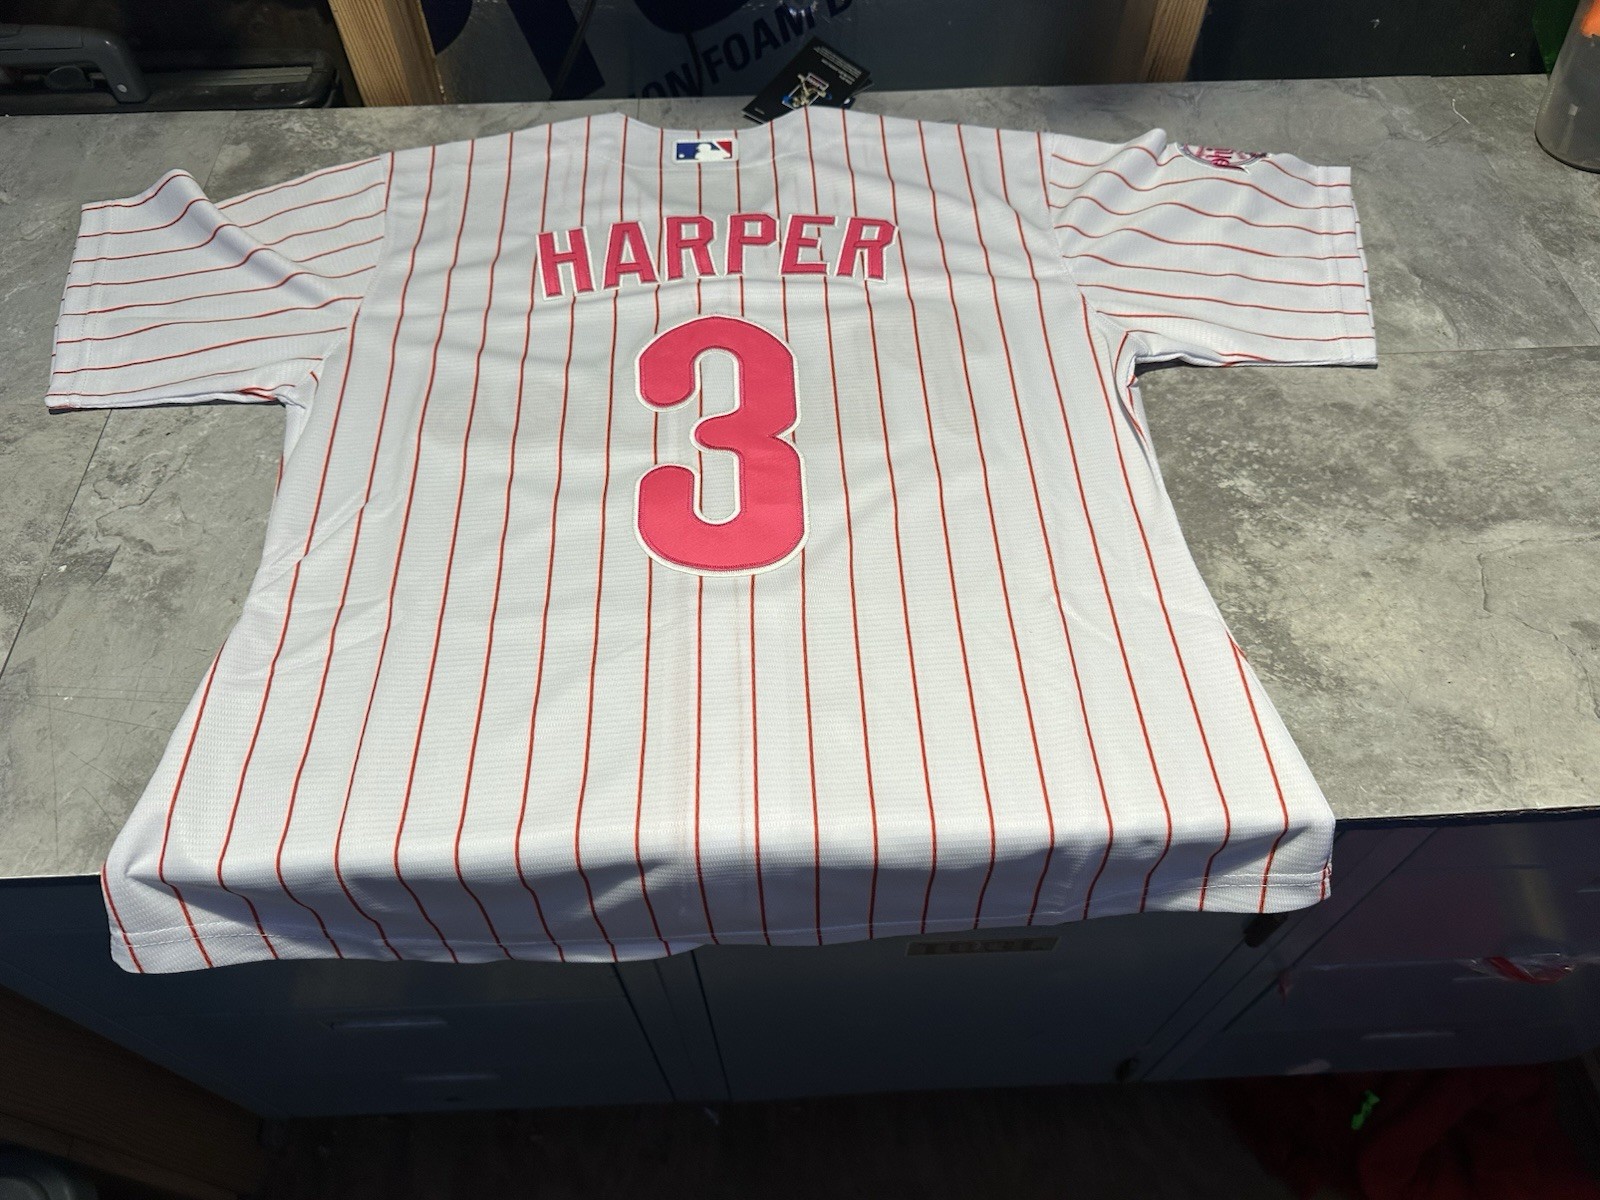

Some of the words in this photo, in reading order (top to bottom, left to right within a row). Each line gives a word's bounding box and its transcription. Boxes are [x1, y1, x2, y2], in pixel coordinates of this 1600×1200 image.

[701, 3, 815, 84] FOAM
[536, 212, 898, 300] HARPER
[634, 314, 809, 577] 3
